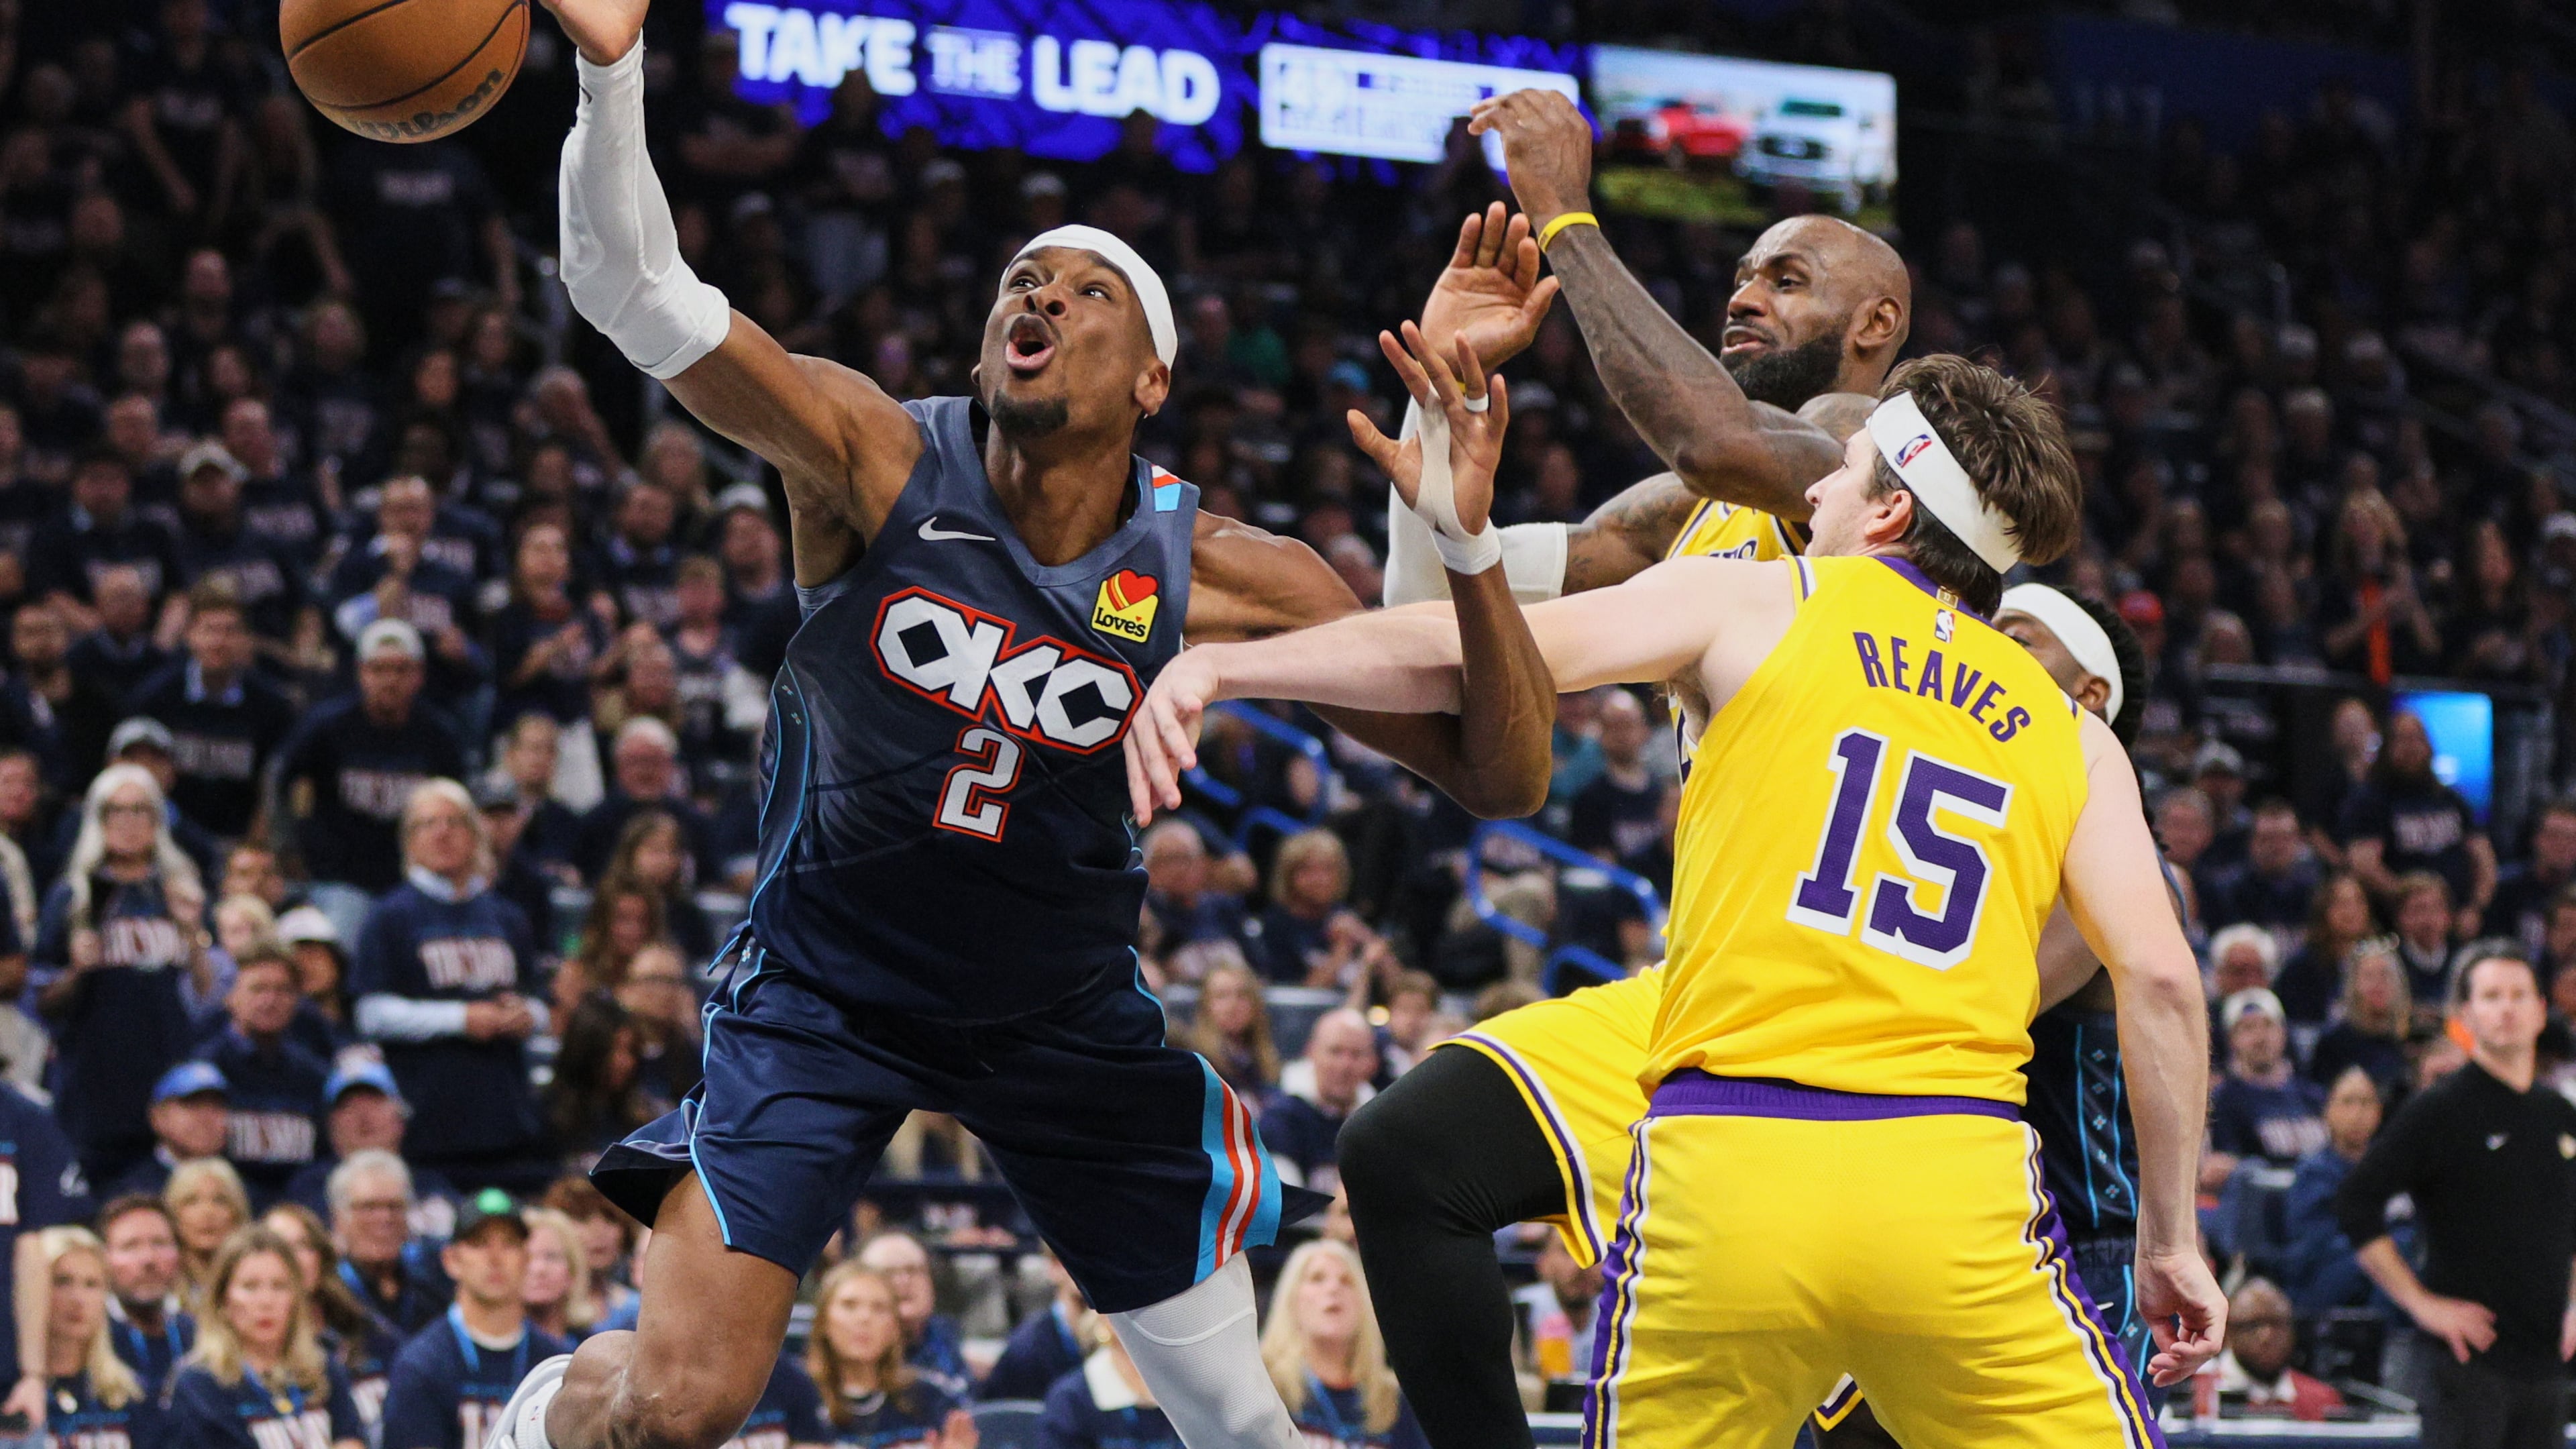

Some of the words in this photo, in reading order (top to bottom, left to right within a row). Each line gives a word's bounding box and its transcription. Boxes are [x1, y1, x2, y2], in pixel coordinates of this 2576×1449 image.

[724, 2, 916, 97] TAKE
[924, 32, 1022, 95] THE
[1032, 35, 1220, 126] LEAD
[872, 588, 1142, 752] OKC
[1854, 631, 2031, 743] REAVES
[934, 724, 1024, 841] 2
[1785, 725, 2015, 971] 15
